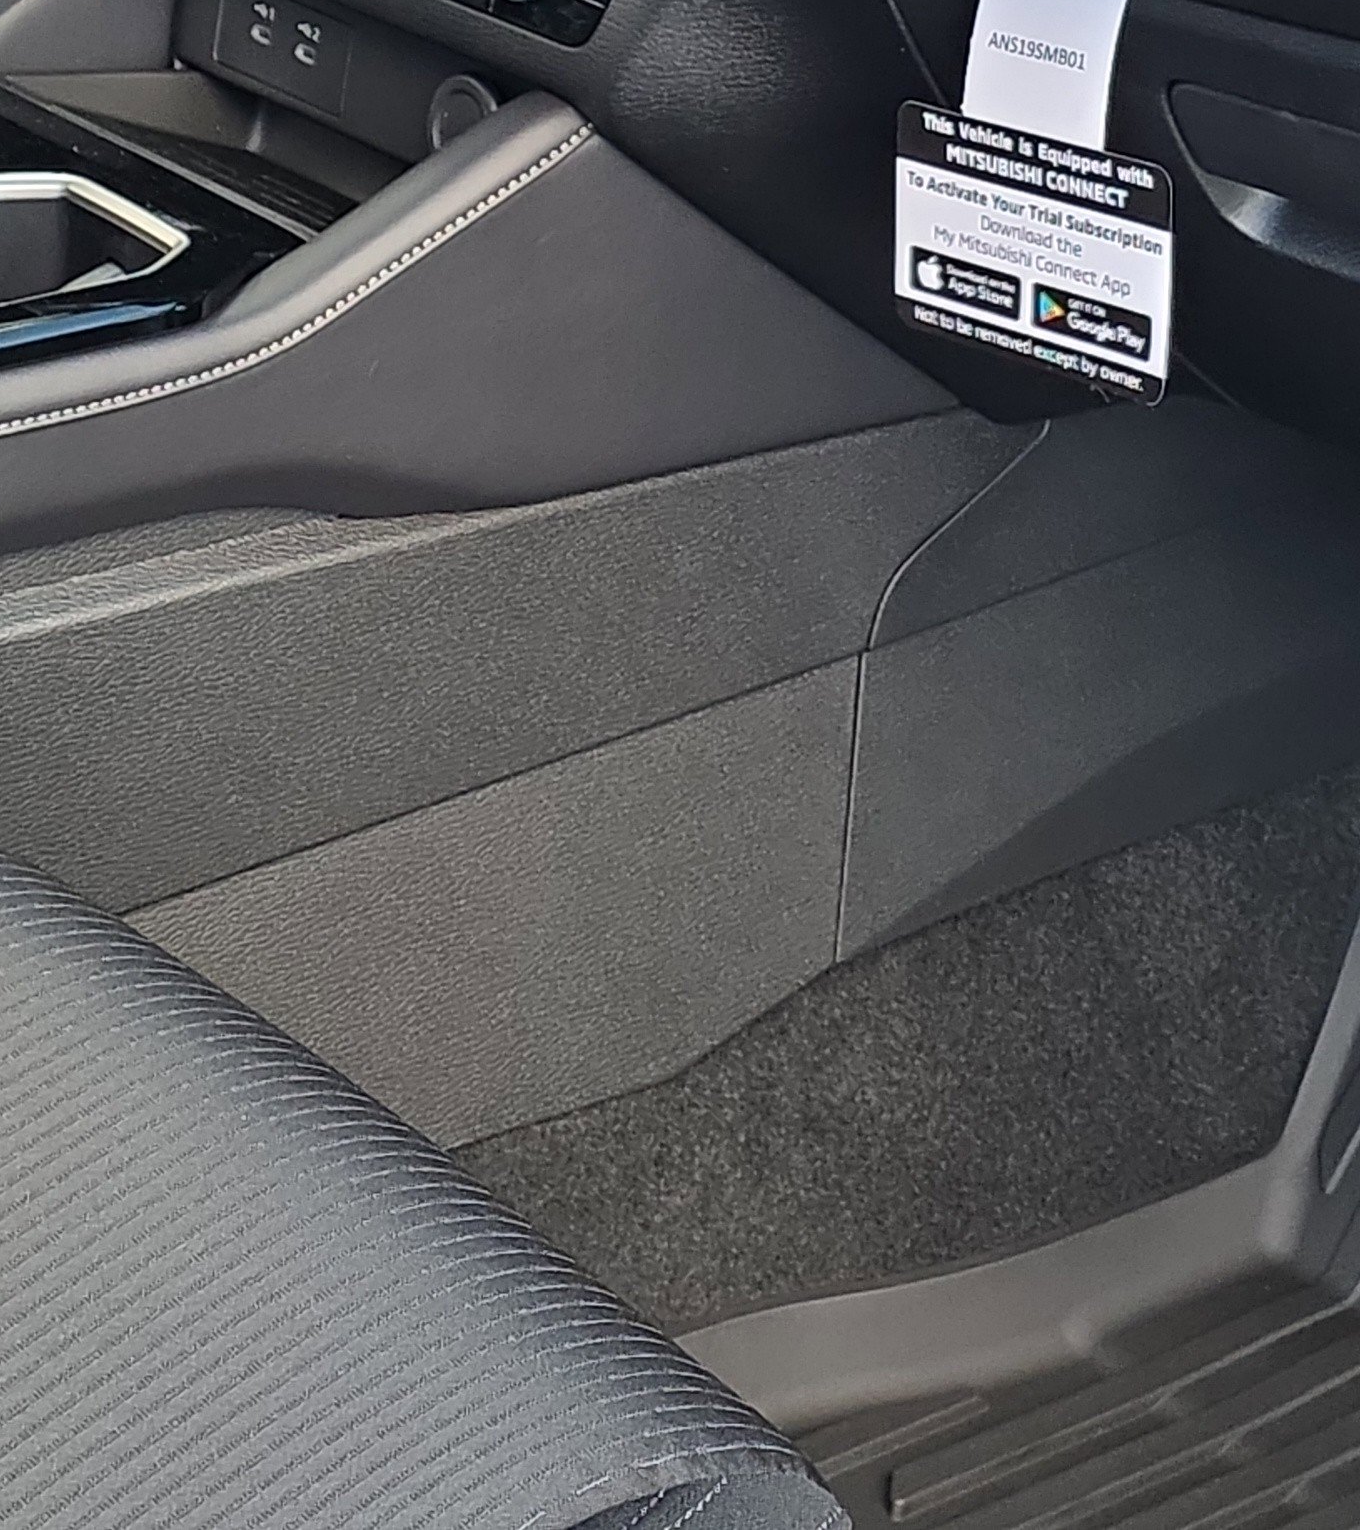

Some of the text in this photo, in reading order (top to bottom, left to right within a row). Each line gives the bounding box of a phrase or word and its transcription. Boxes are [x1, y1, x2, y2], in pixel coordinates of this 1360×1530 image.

[988, 31, 1086, 71] ANS19SMB01
[922, 111, 1155, 190] This Vehicle is Equipped with
[945, 143, 1129, 209] MITSUBISHI CONNECT
[907, 170, 1163, 256] To Activate Your Trial Subscription
[980, 215, 1083, 258] Download the
[933, 225, 1132, 298] My Mitsubishi Connect App
[948, 276, 1014, 309] App Store
[914, 304, 1144, 392] Not to be removed except by owner.
[1066, 311, 1146, 354] Google Play
